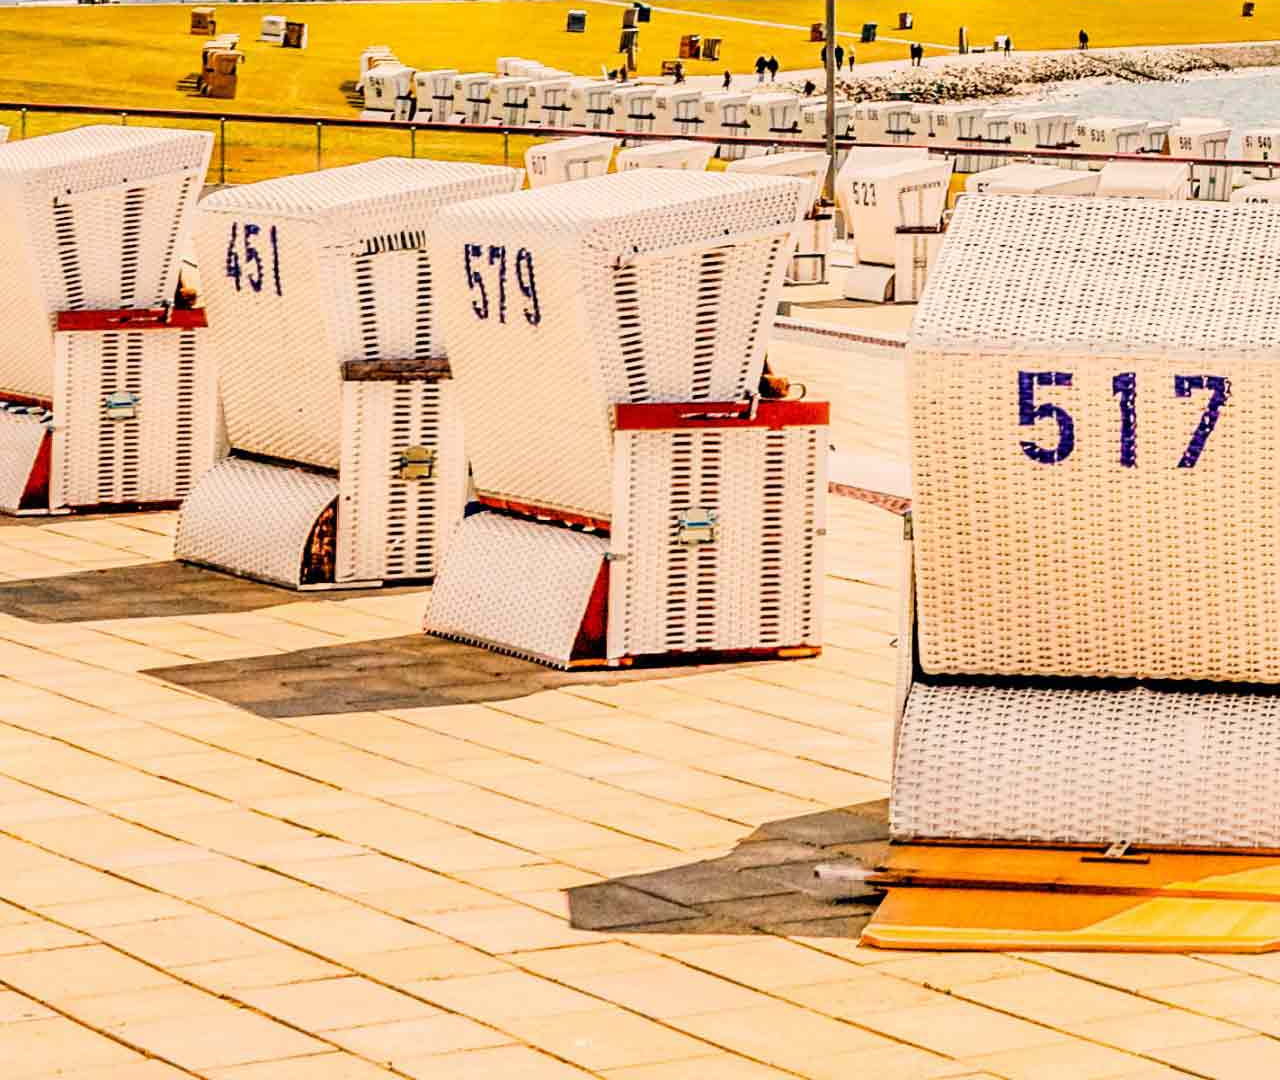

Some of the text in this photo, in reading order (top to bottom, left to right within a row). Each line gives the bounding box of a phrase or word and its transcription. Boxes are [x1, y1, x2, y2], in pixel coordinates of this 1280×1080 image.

[852, 181, 877, 207] 523
[225, 222, 283, 297] 451
[464, 243, 542, 327] 579
[1017, 370, 1231, 469] 517
